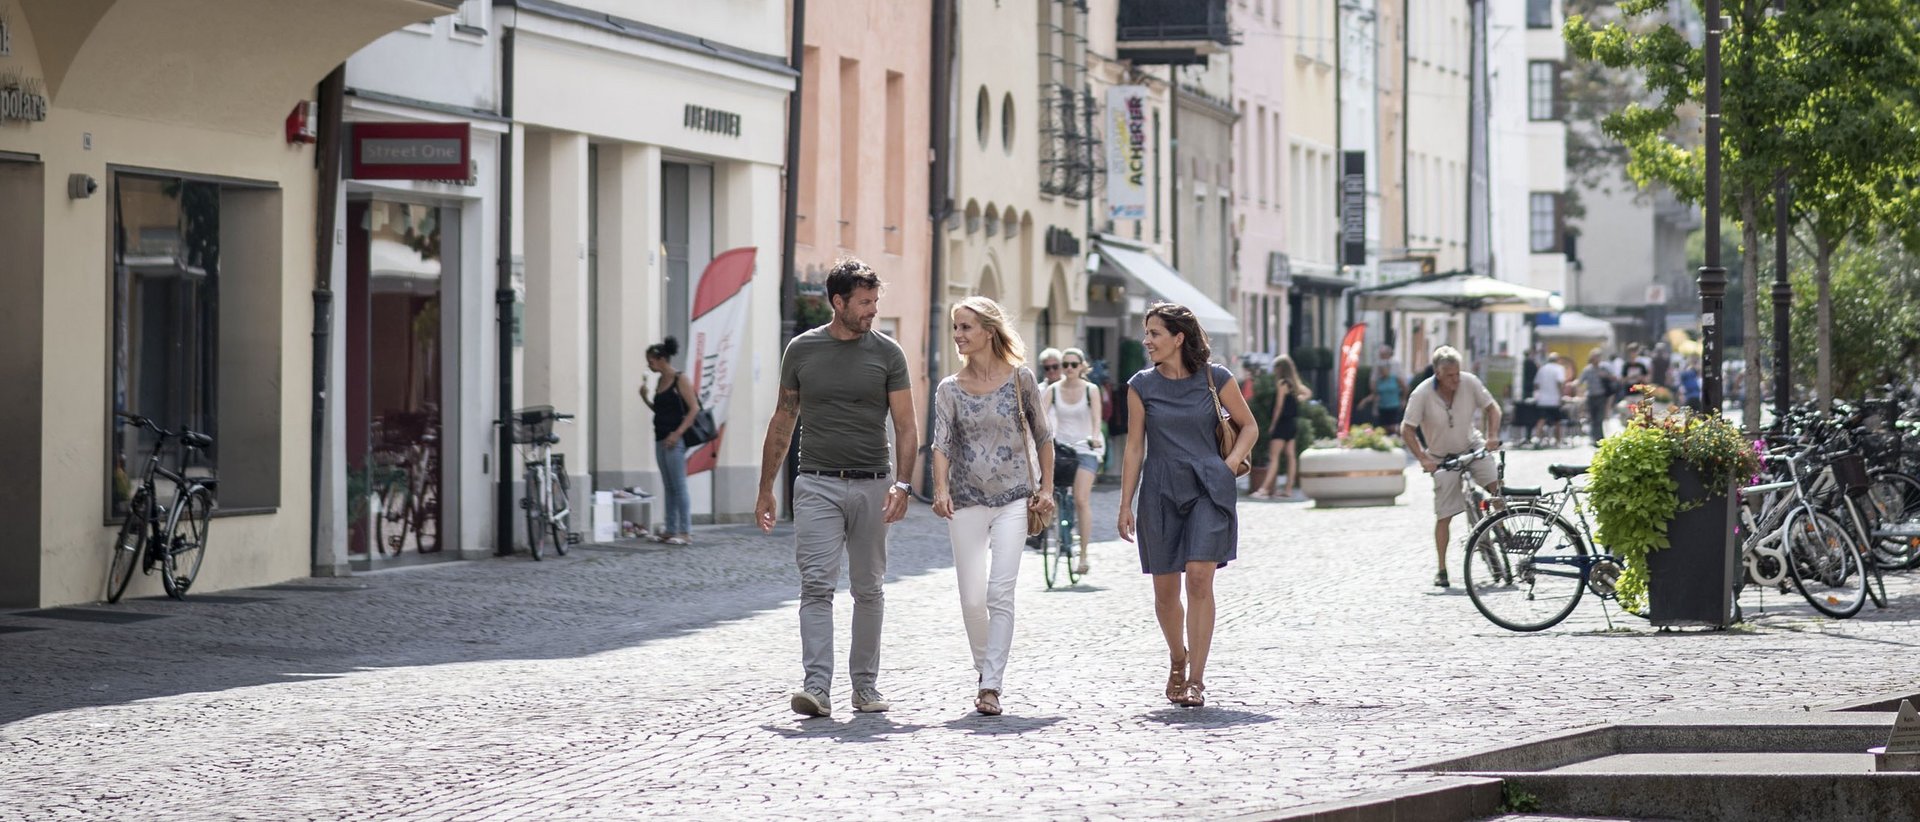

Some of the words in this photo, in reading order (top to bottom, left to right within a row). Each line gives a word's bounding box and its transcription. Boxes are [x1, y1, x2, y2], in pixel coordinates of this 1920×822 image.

[367, 144, 417, 158] Street
[422, 144, 455, 158] One
[1130, 97, 1143, 186] ACHERER
